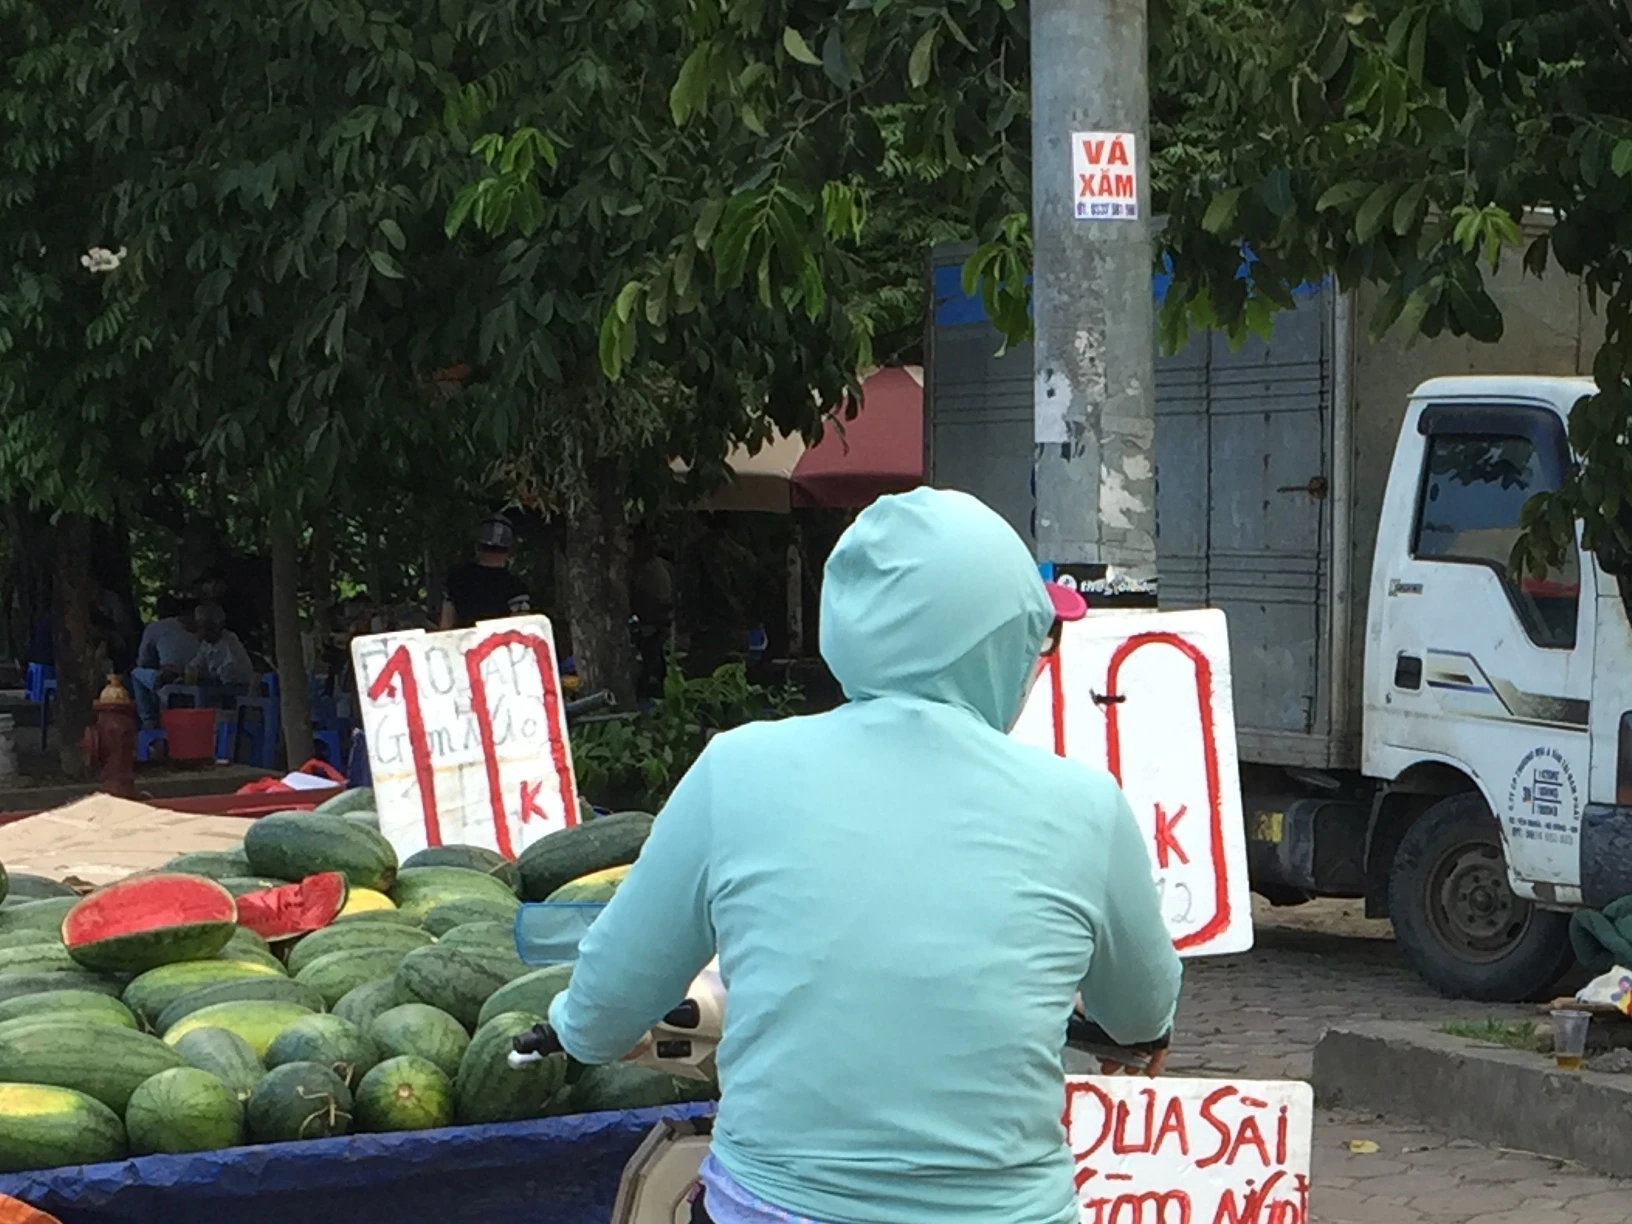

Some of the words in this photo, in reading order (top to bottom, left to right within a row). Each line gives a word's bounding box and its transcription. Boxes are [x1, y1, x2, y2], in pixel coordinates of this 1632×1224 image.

[1079, 168, 1134, 198] XĂM
[520, 780, 549, 824] K
[1153, 802, 1190, 869] K
